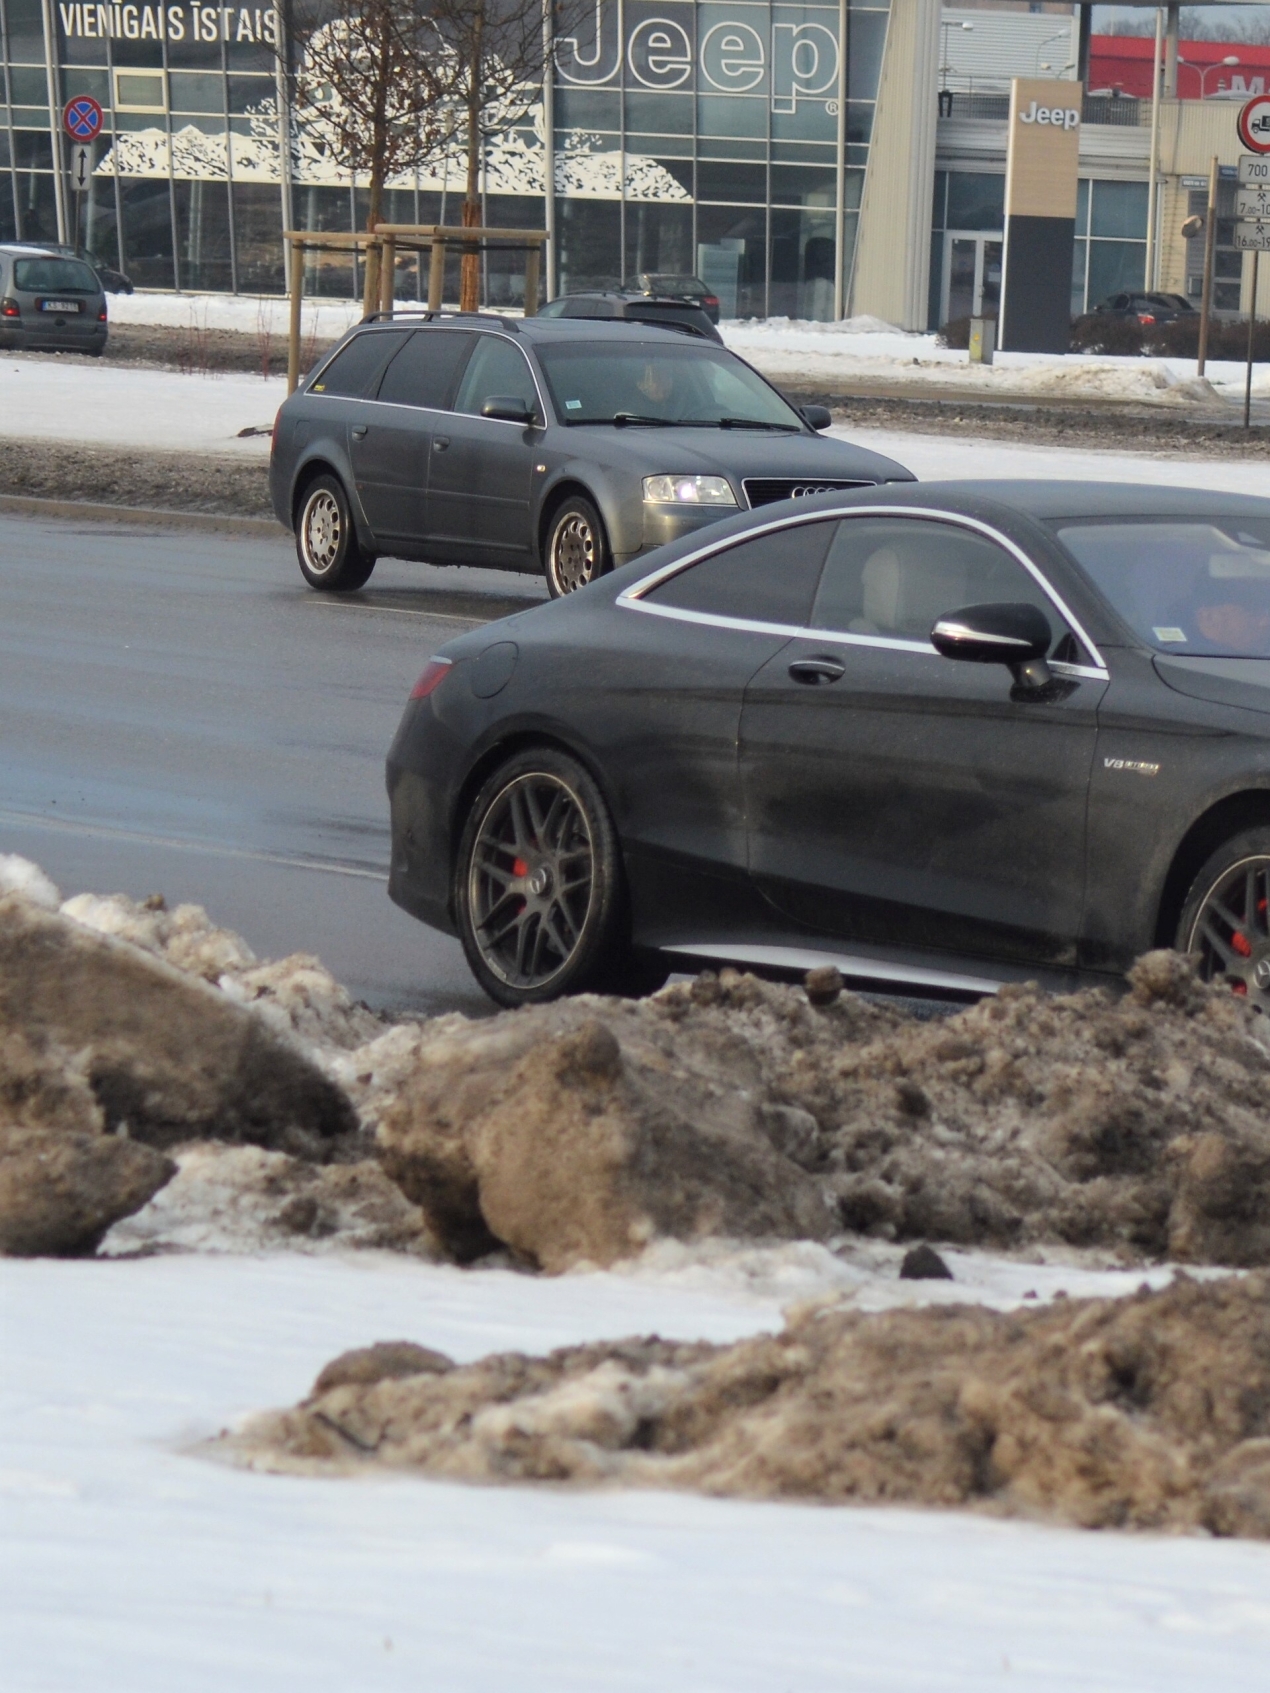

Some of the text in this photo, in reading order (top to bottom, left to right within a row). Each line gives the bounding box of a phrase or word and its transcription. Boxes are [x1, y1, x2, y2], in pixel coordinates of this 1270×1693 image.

[59, 0, 276, 43] VIENĪGAIS ĪSTAIS
[553, 0, 839, 114] Jeep
[1019, 101, 1080, 131] Jeep
[1248, 163, 1268, 177] 700
